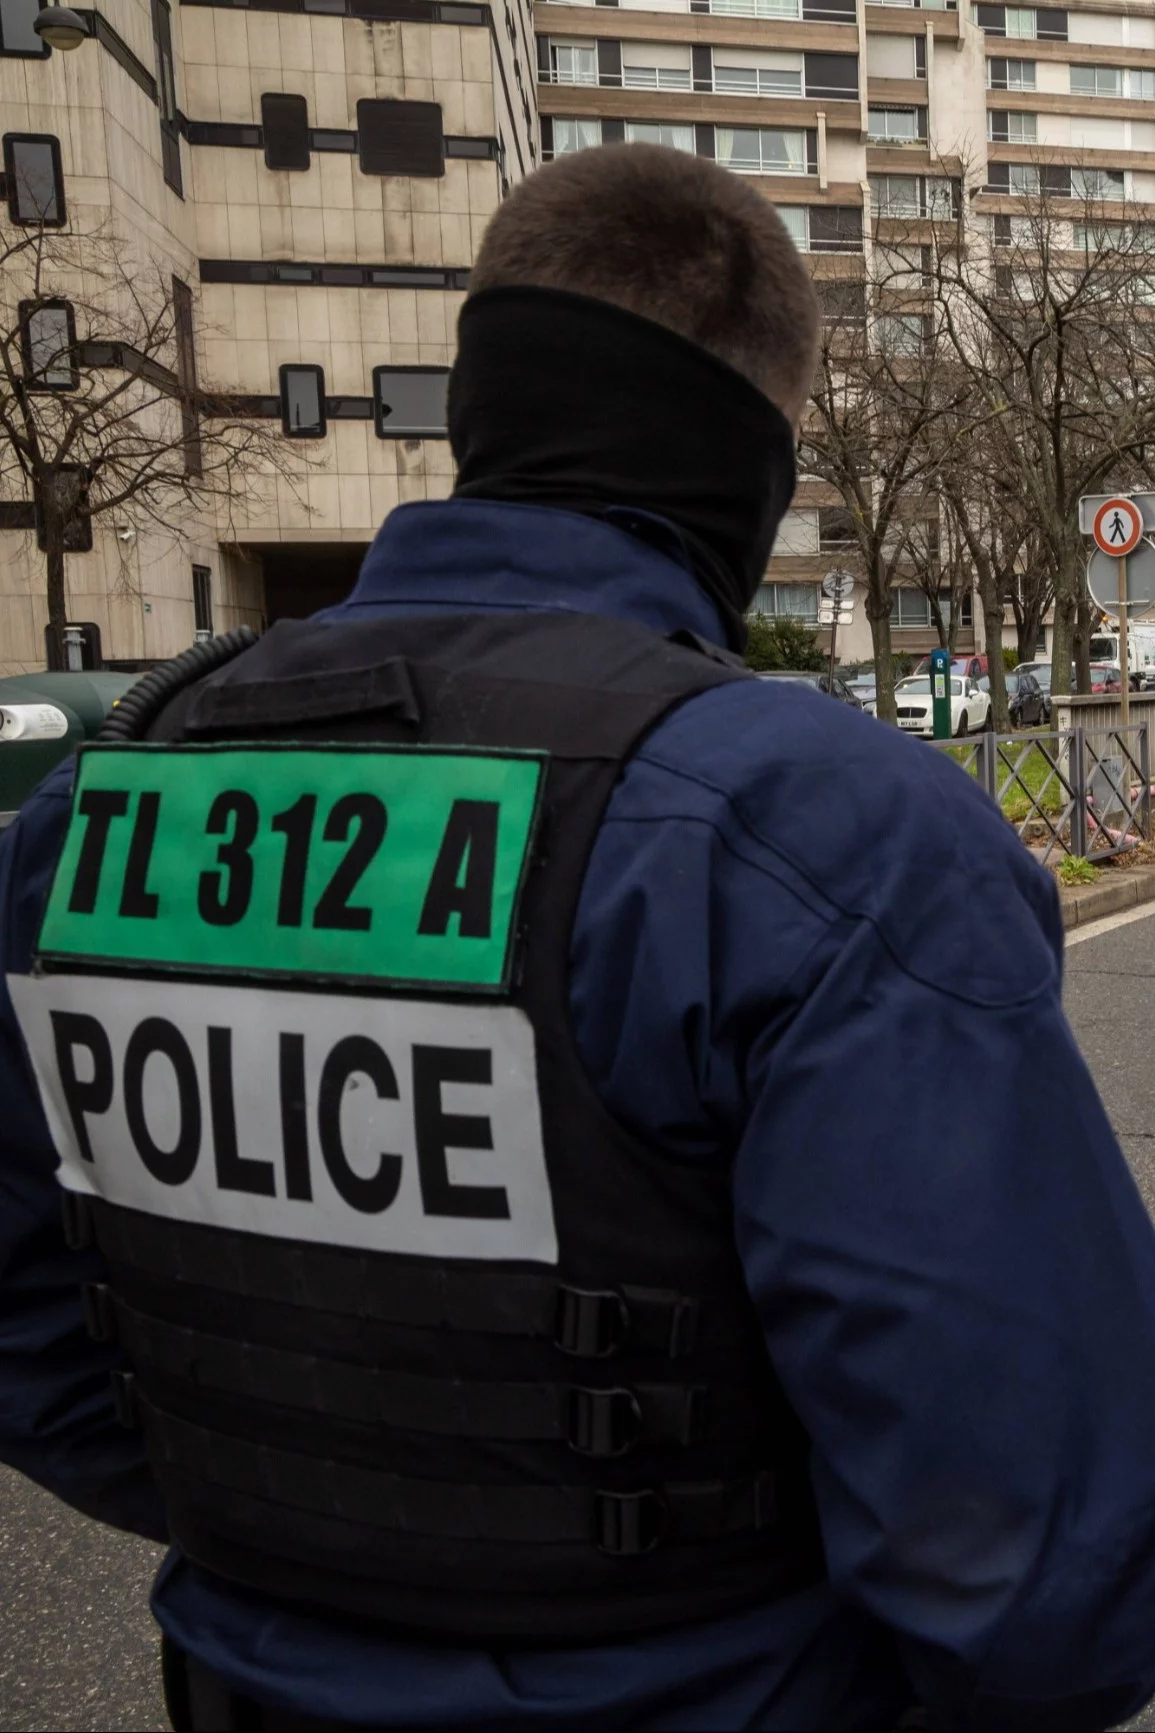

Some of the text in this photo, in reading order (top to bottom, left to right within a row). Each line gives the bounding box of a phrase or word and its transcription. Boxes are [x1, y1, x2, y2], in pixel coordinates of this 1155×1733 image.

[68, 788, 501, 939] TL 312 A
[49, 1010, 511, 1220] POLICE
